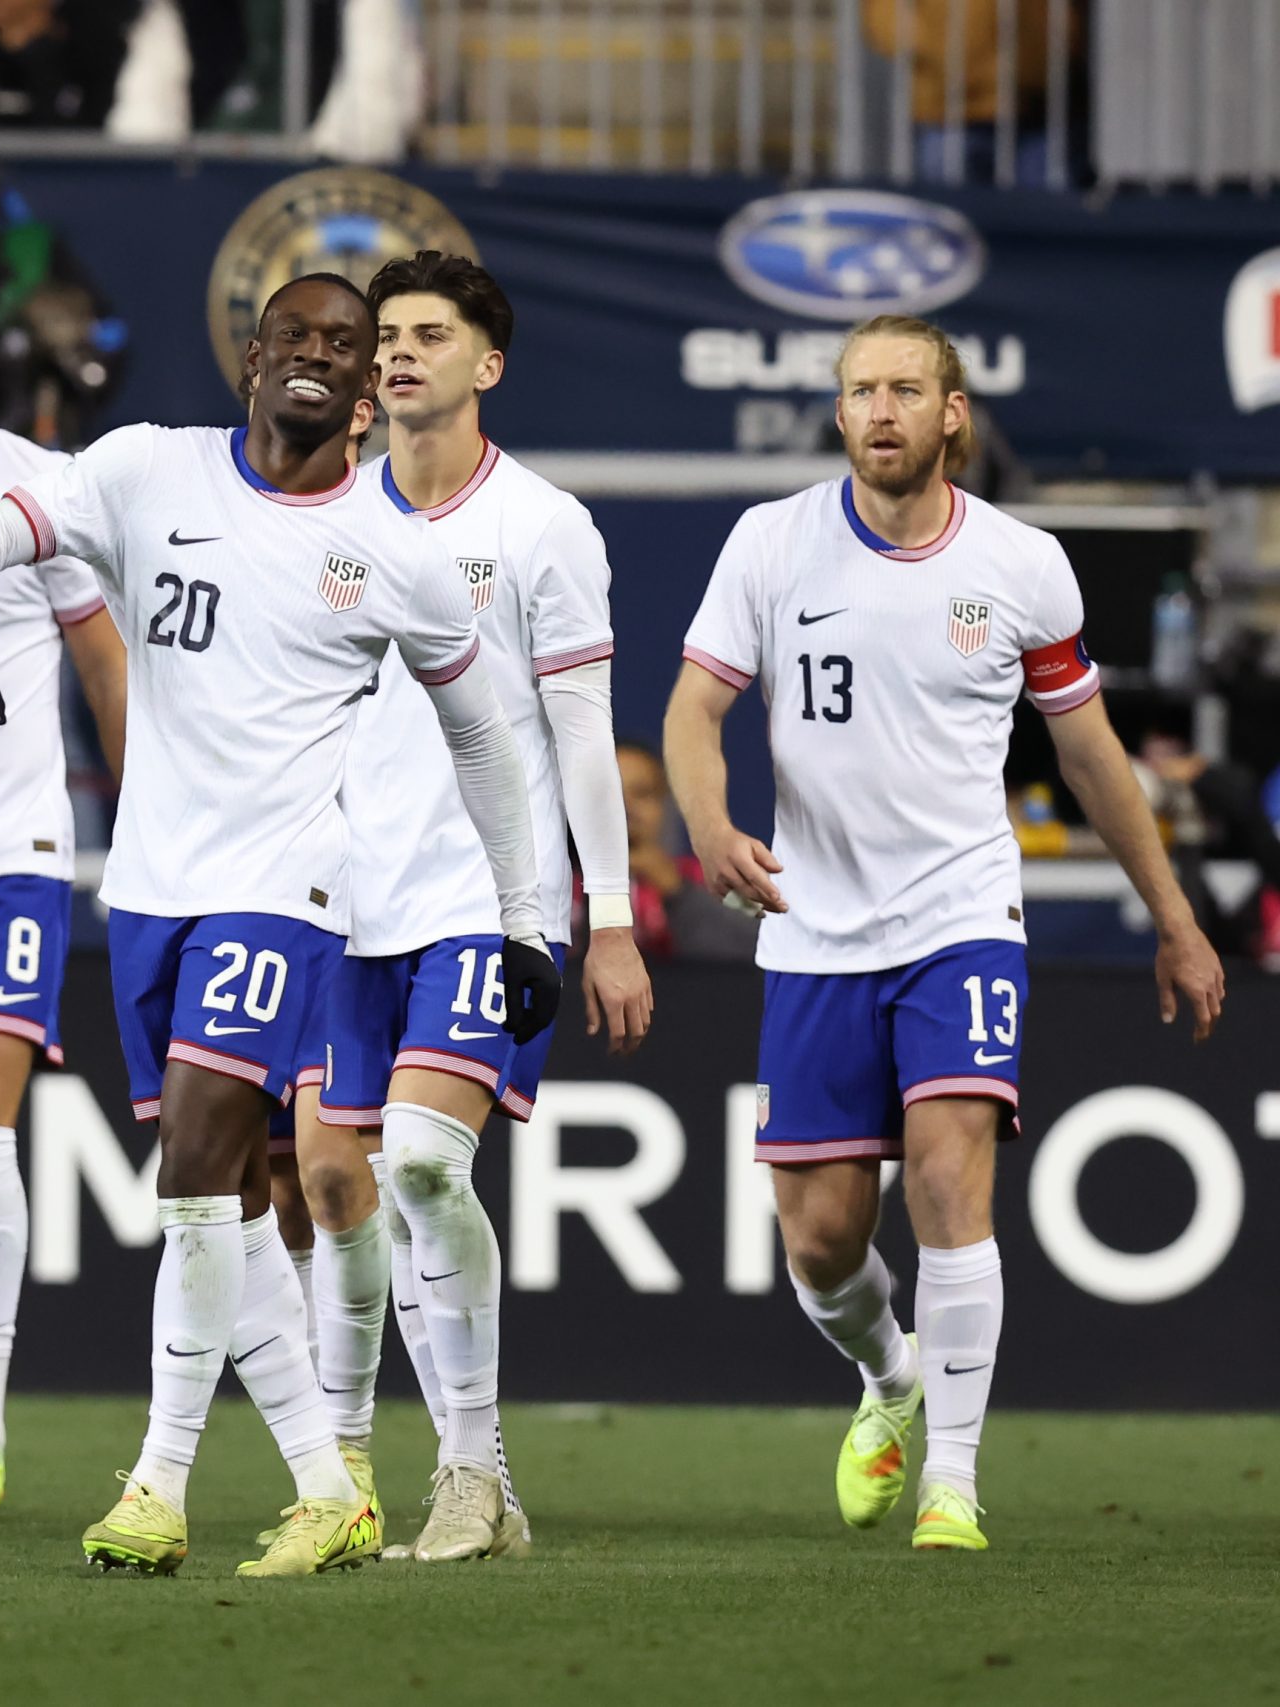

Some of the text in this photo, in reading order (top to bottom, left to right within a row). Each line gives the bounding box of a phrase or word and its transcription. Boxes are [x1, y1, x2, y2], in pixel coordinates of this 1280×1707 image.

[328, 556, 367, 581] USA
[147, 571, 221, 653] 20
[952, 602, 988, 625] USA
[797, 653, 853, 724] 13
[5, 915, 42, 984] 8
[201, 941, 288, 1023] 20
[963, 975, 1018, 1048] 13
